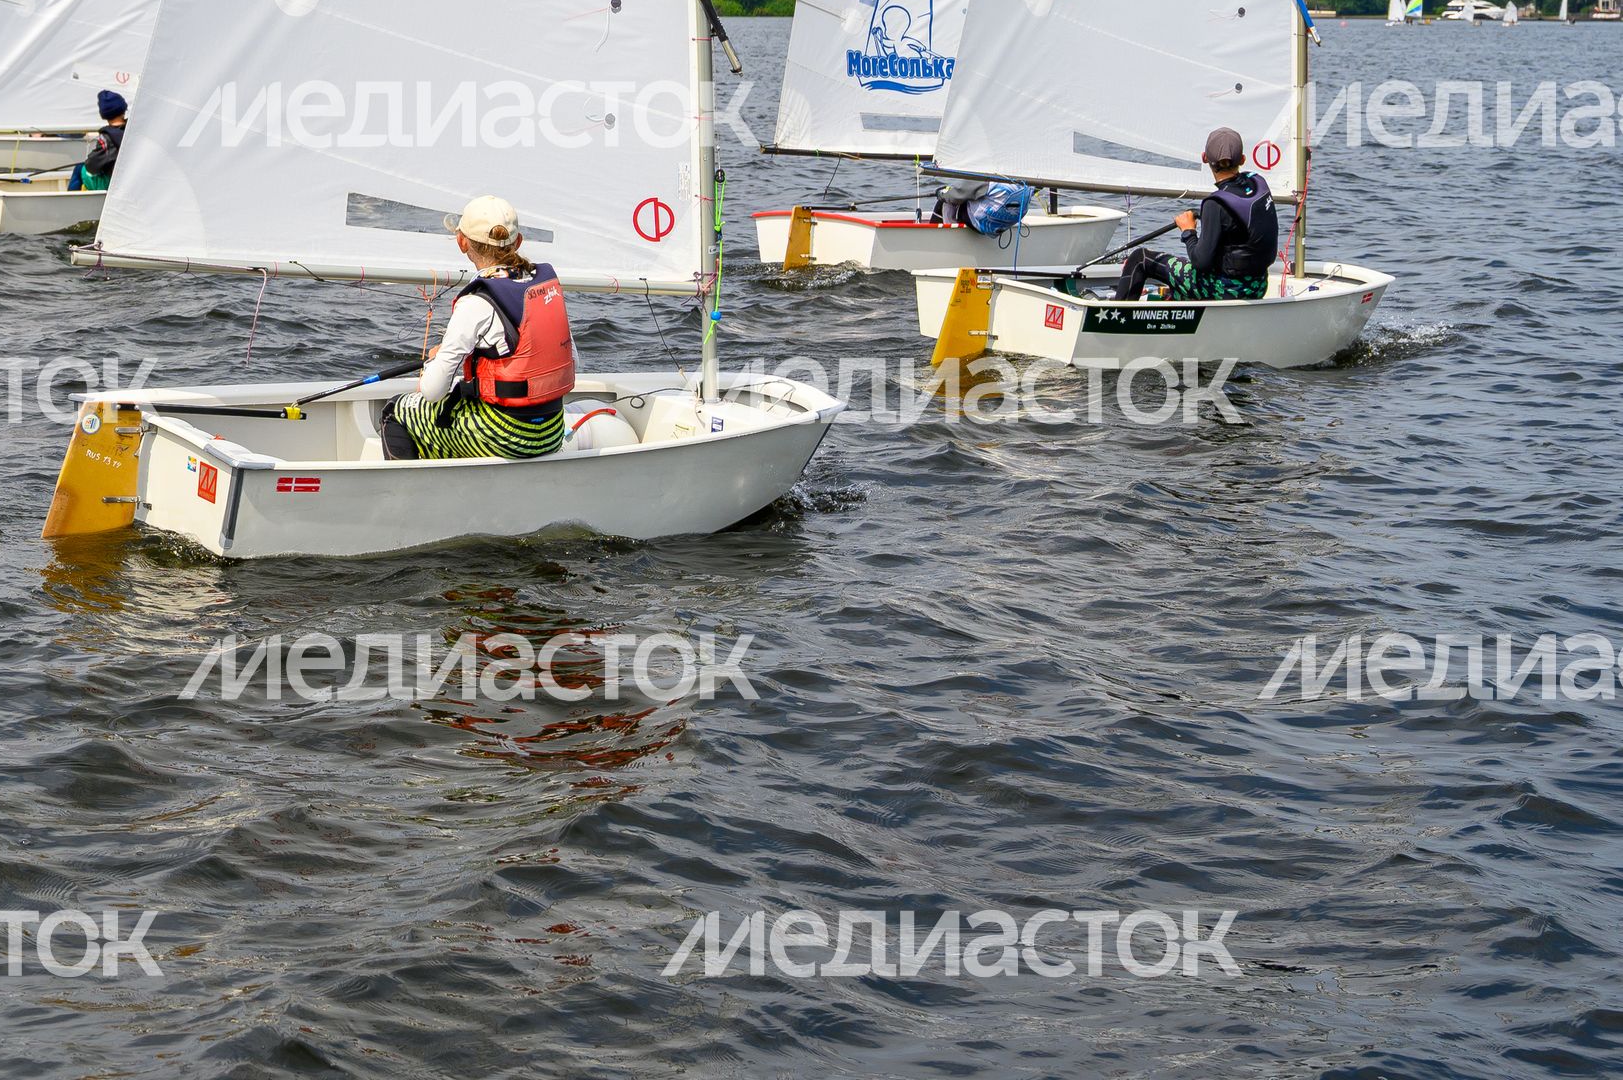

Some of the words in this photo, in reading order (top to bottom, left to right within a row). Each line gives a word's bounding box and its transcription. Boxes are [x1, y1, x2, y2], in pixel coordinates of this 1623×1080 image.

[1132, 309, 1169, 320] WINNER
[1170, 309, 1196, 320] TEAM
[85, 448, 101, 461] RUS
